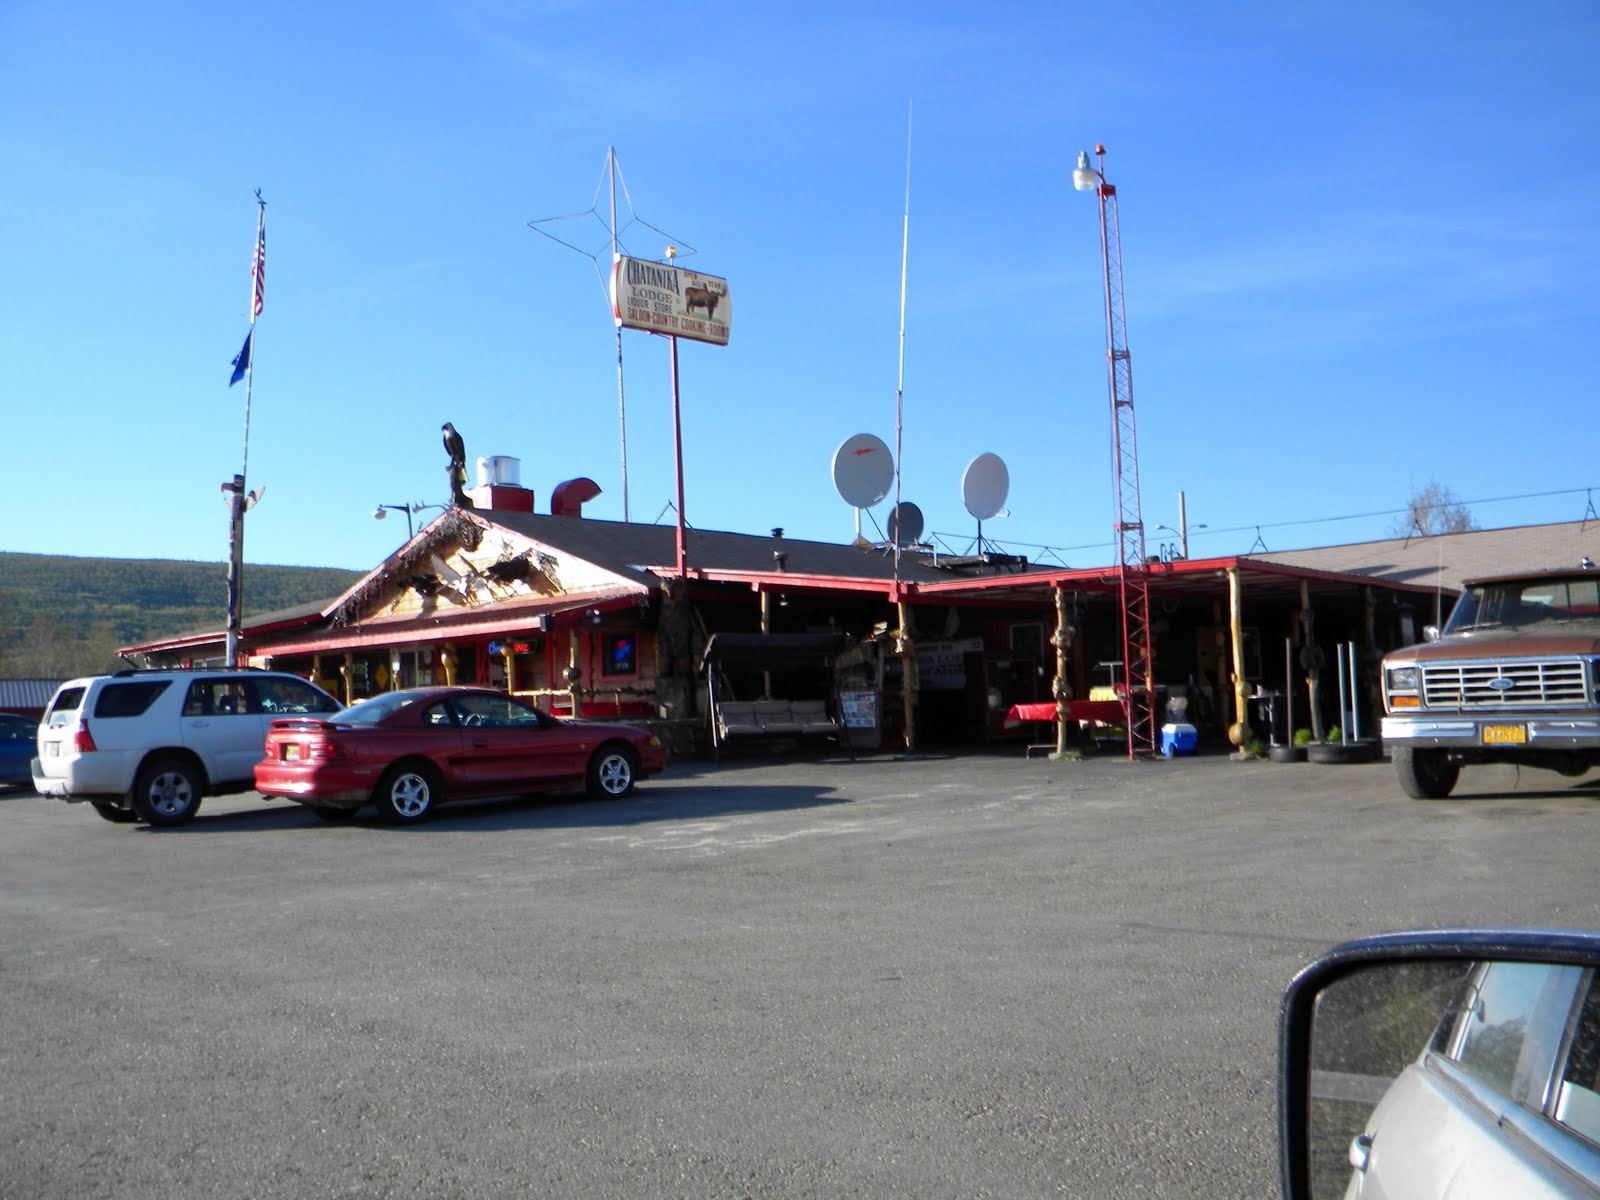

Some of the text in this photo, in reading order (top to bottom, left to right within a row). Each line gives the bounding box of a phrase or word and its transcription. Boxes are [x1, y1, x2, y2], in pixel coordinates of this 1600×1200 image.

[627, 258, 680, 296] CHATANIKA
[632, 286, 672, 304] LODGE
[627, 296, 648, 309] LIQUOR
[654, 301, 672, 314] STORE
